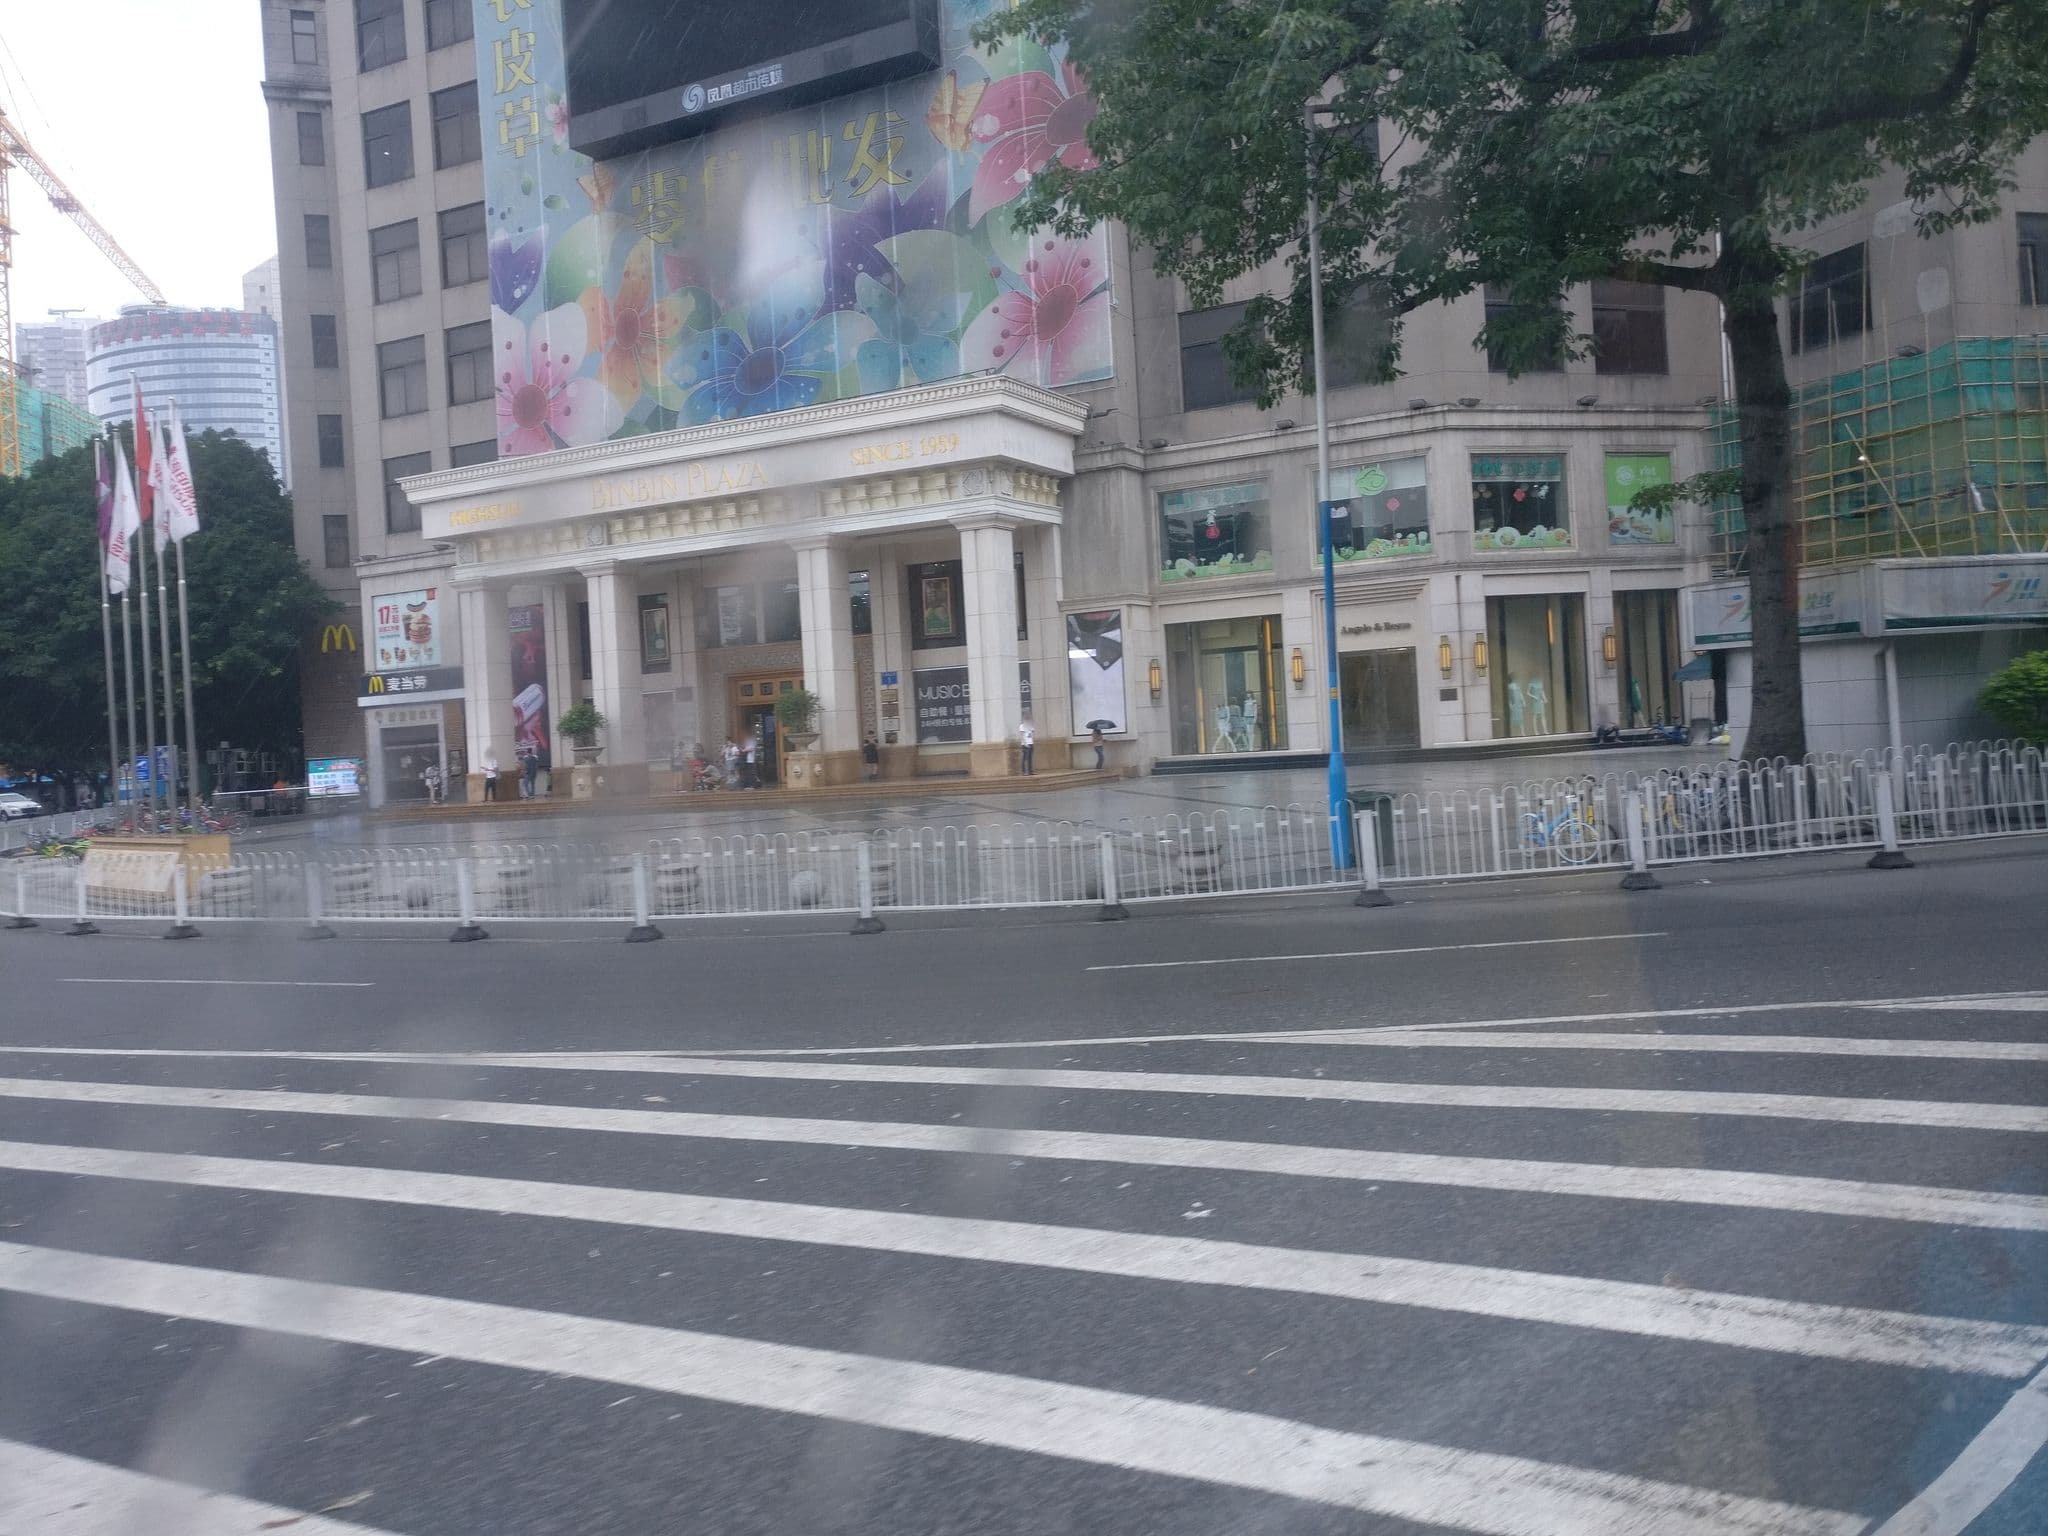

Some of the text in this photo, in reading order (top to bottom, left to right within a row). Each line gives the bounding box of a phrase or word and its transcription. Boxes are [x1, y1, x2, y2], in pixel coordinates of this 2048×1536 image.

[591, 473, 681, 510] BINBIN
[687, 462, 768, 498] PLAZA
[850, 440, 913, 465] SINCE
[919, 433, 961, 456] 1959
[386, 675, 428, 692] 麦当劳
[919, 685, 961, 700] MUSIC
